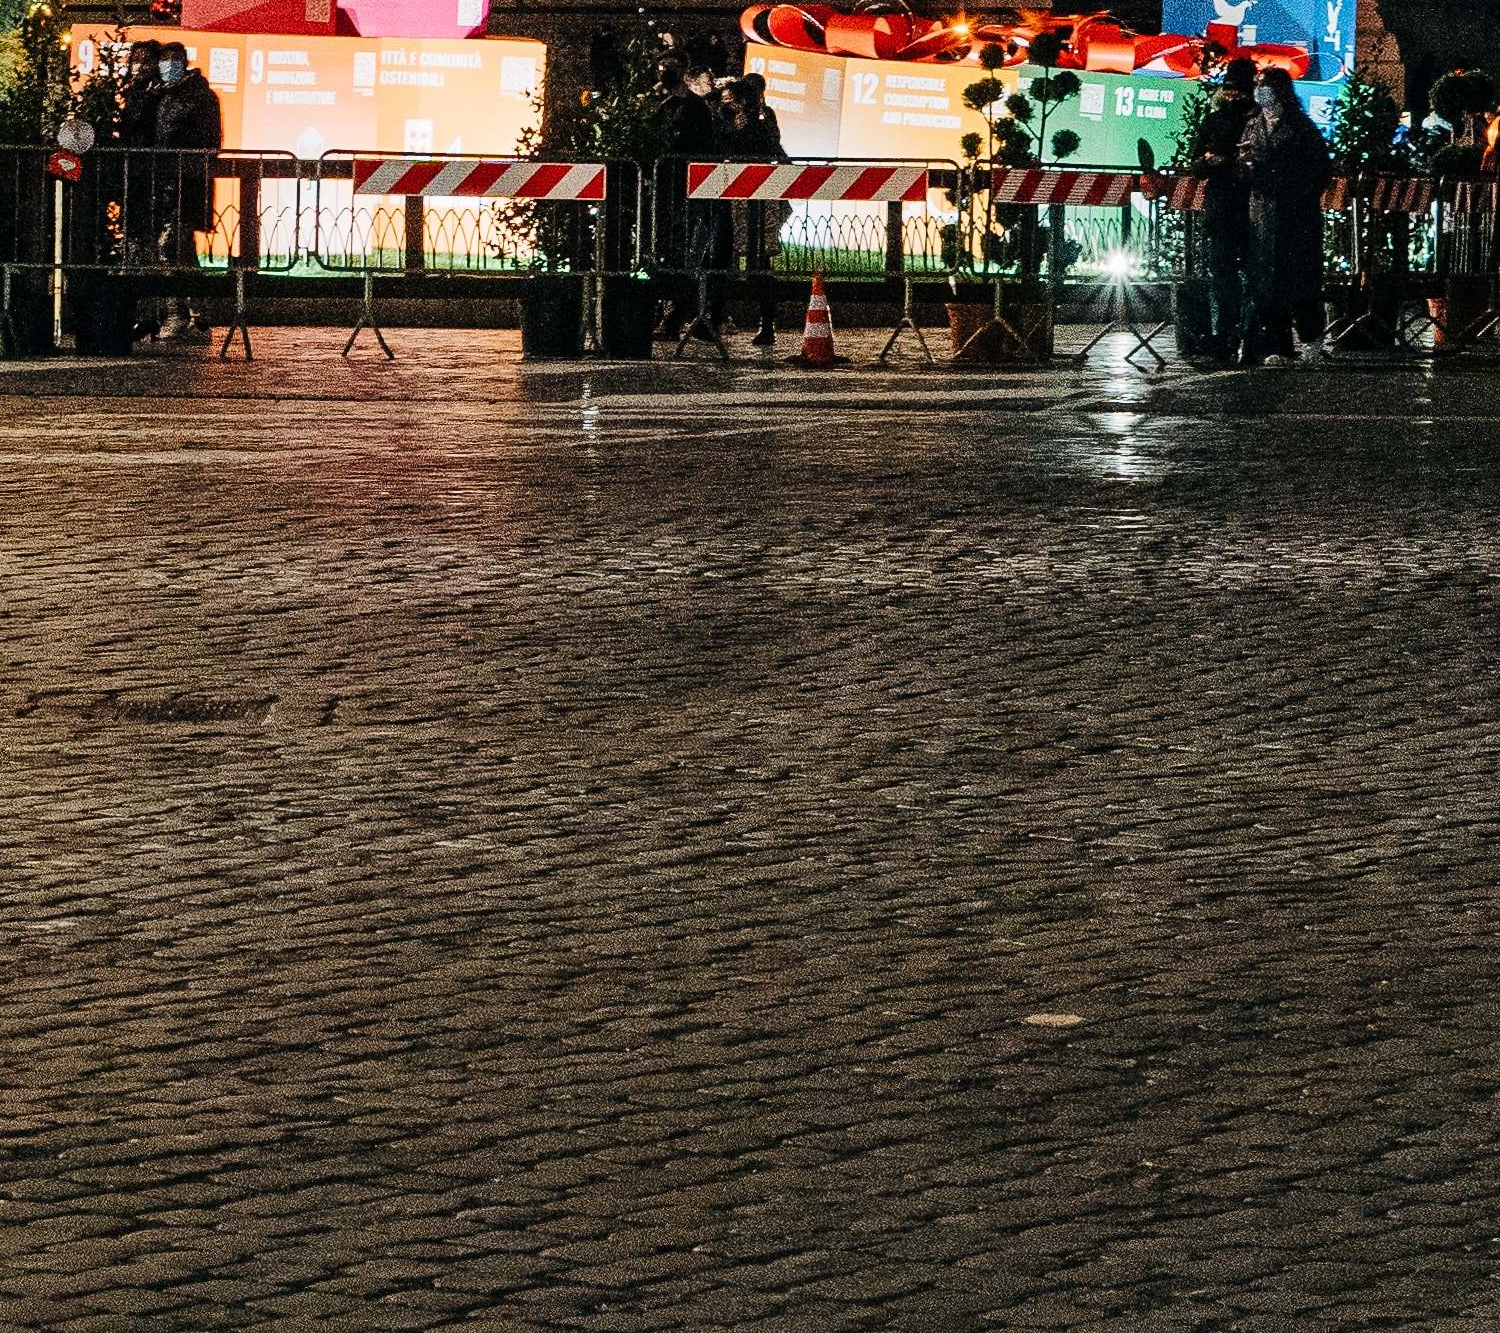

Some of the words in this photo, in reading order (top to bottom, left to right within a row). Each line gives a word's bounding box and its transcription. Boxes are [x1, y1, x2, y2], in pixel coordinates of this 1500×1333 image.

[78, 40, 94, 74] 9
[250, 50, 264, 84] 9
[380, 48, 407, 65] ITTÀ
[410, 51, 418, 66] E
[419, 51, 483, 69] COMUNITÀ
[379, 71, 445, 87] OSTENIBILI
[852, 73, 879, 105] 12
[885, 75, 946, 92] RESPONSIBLE
[884, 93, 950, 110] CONSUMPTION
[1115, 86, 1135, 117] 13
[882, 111, 902, 125] AND
[903, 113, 962, 129] PRODUCTION
